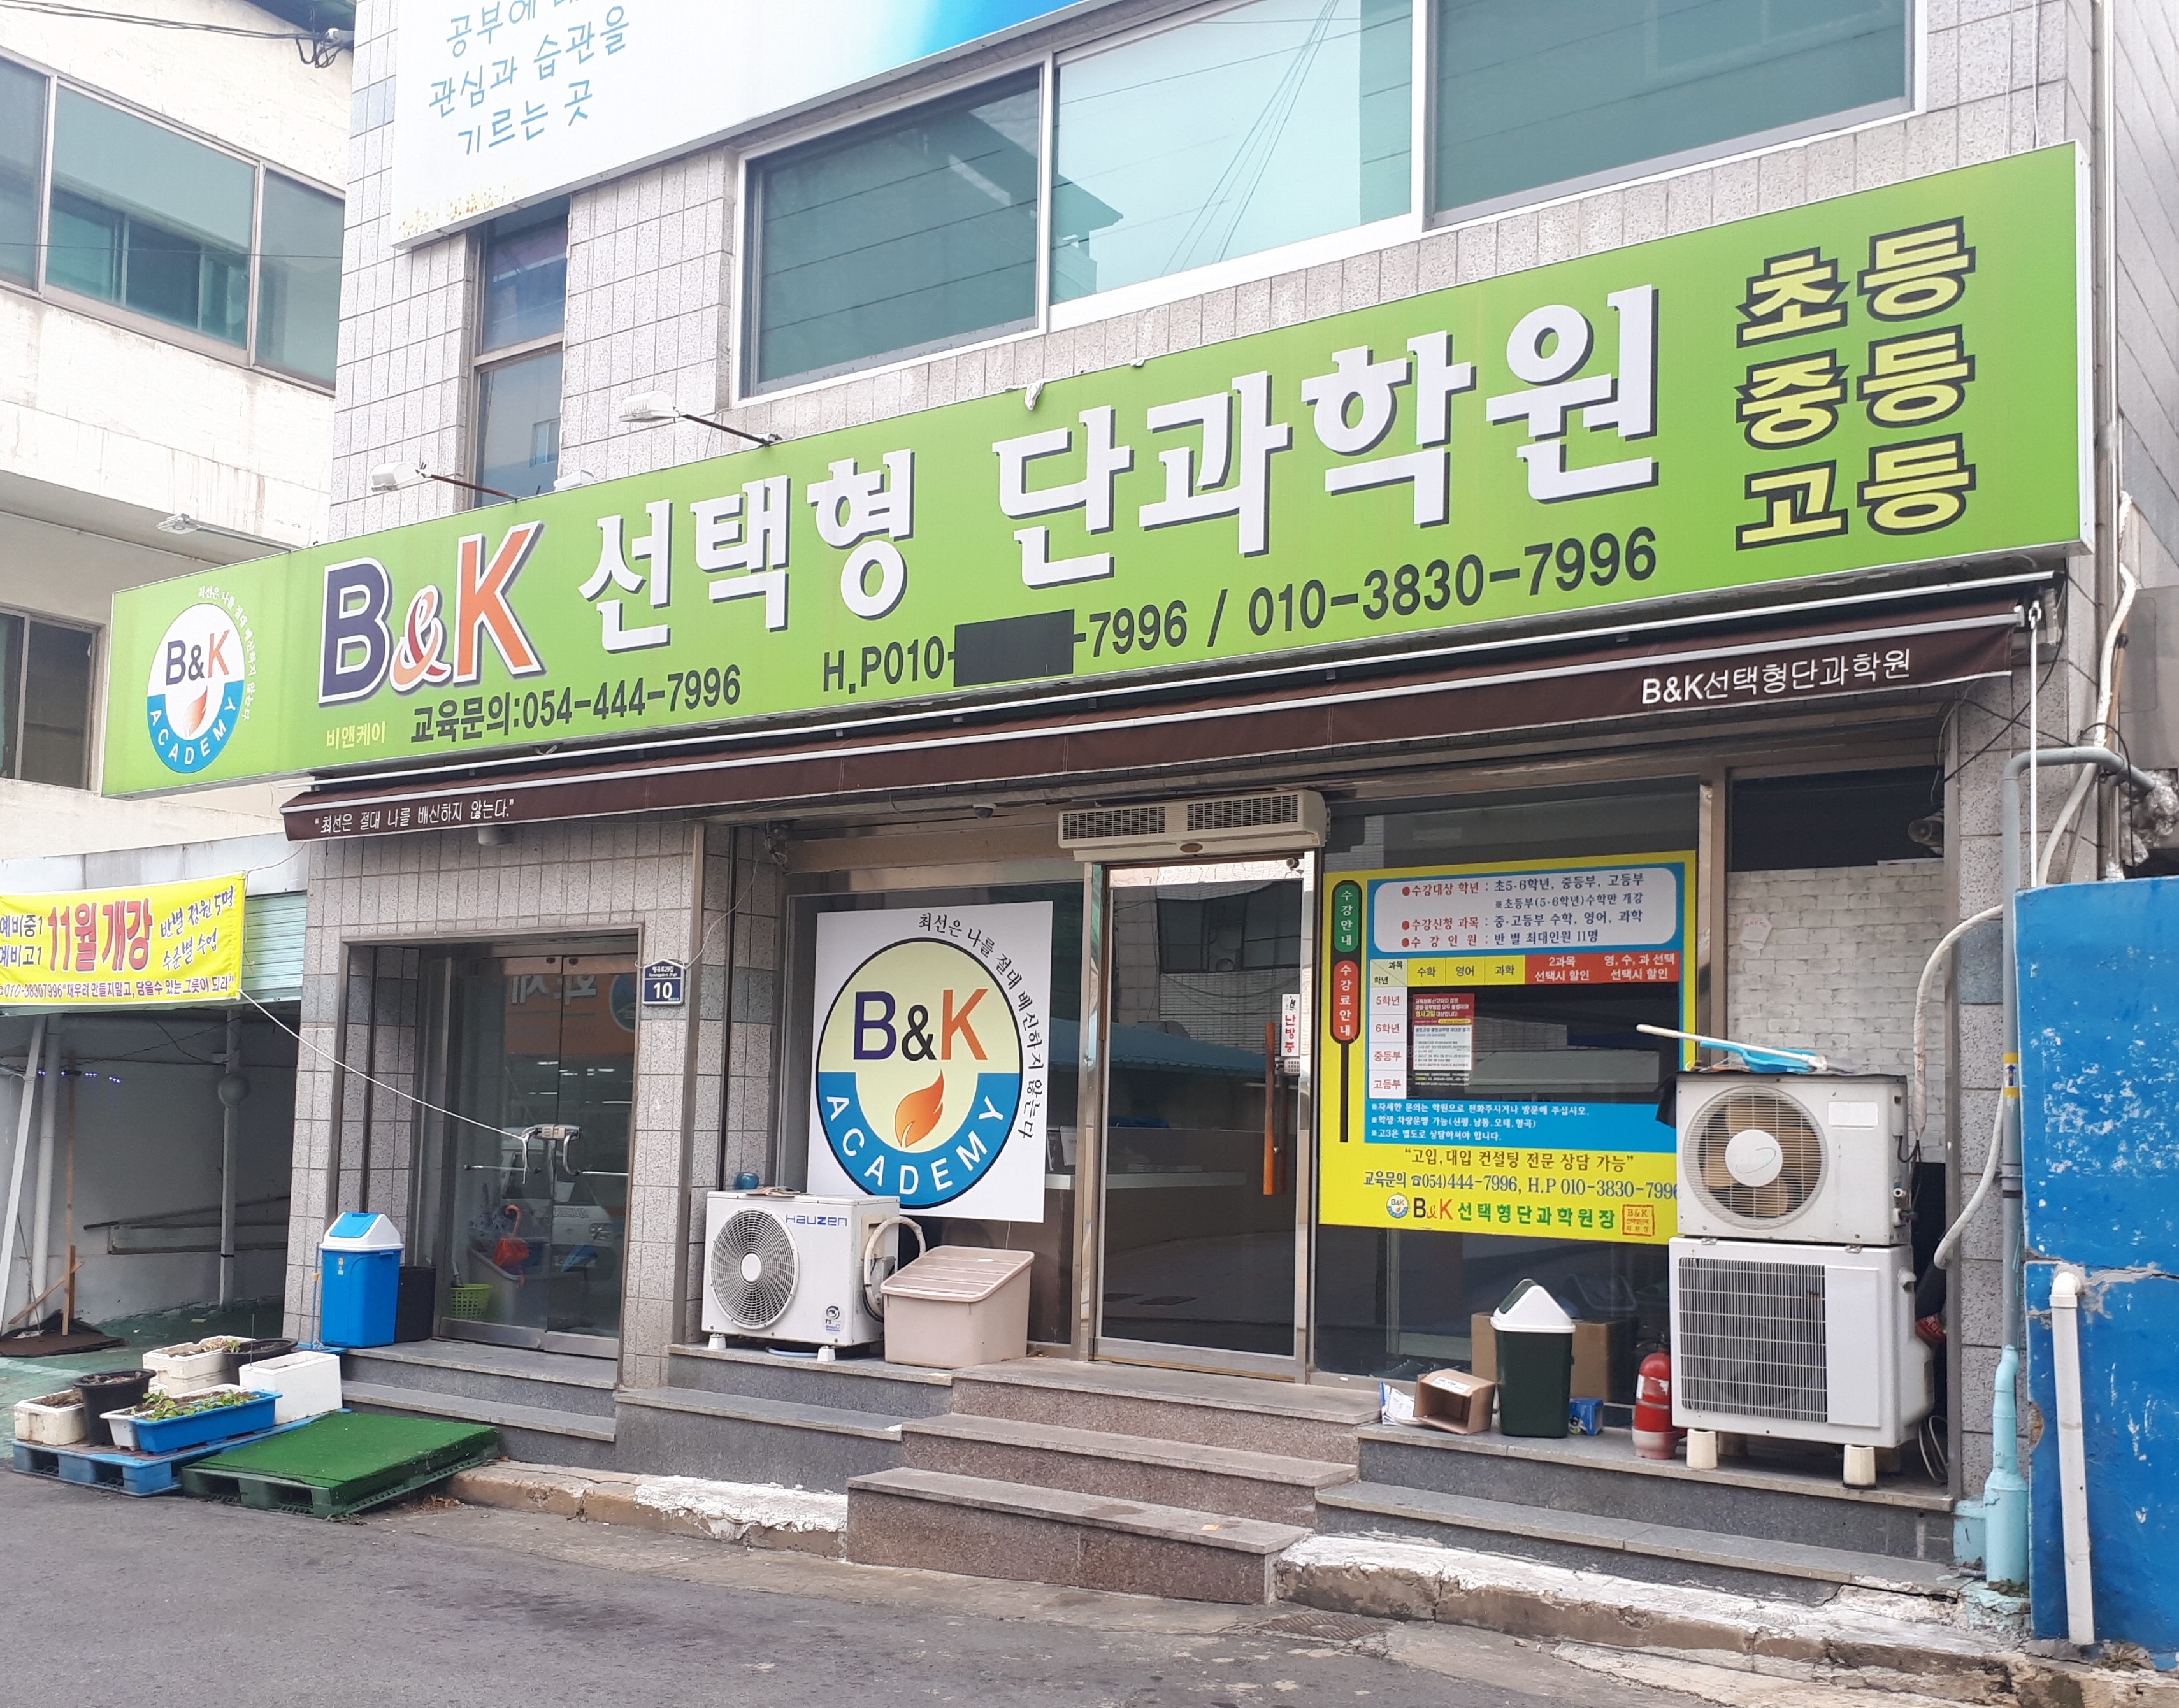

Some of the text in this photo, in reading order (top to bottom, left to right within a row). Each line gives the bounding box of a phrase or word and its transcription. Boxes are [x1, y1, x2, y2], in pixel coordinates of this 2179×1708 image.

[429, 6, 629, 119] 관심과 습관을
[457, 80, 593, 155] 기르는 곳
[1736, 215, 1976, 348] 초등
[1734, 324, 1976, 450] 중등
[318, 283, 1659, 707] B&K 선택형 단과학원
[1736, 432, 1976, 551] 고등
[1248, 527, 1657, 636] 010-3830-7996
[198, 585, 220, 599] 최선은
[221, 592, 235, 610] 나를
[165, 629, 230, 686] B&K
[1641, 648, 1911, 705] B&K선택형단과학원
[150, 697, 236, 764] ACADEMY
[326, 721, 386, 750] 비앤케이
[360, 810, 380, 830] 절대
[387, 807, 411, 827] 나를
[418, 801, 463, 824] 배신하지
[1411, 883, 1454, 897] 수강대상
[1458, 881, 1479, 895] 학년
[1607, 872, 1644, 887] 고등부
[1622, 891, 1644, 905] 개강
[161, 885, 233, 937] 반별 정원 5명
[1411, 917, 1453, 931] 수강신청
[1457, 916, 1479, 929] 과목
[1618, 909, 1643, 923] 과학
[0, 914, 43, 937] 예비중1
[48, 898, 153, 972] 11월 개강
[1526, 929, 1572, 945] 최대인원
[0, 945, 41, 967] 예비고1
[162, 927, 217, 970] 수준별 수업
[1653, 952, 1675, 965] 선택
[1388, 961, 1403, 970] 과목
[1417, 966, 1436, 978] 수학
[1455, 965, 1474, 977] 영어
[1495, 964, 1515, 976] 과학
[1549, 956, 1576, 967] 2과목
[1374, 976, 1388, 985] 학년
[1534, 969, 1590, 982] 선택시 할인
[1610, 967, 1668, 980] 선택시 할인
[165, 979, 182, 995] 있는
[183, 977, 209, 994] 그릇이
[653, 982, 673, 999] 10
[1376, 995, 1400, 1007] 5학년
[852, 988, 989, 1061] B&K
[918, 912, 1044, 1139] 최선은 나를 절대 배신하지 않는다
[1284, 1014, 1296, 1053] 난방중
[1375, 1023, 1400, 1035] 6학년
[1373, 1051, 1402, 1063] 중등부
[1373, 1078, 1402, 1090] 고등부
[1397, 1116, 1429, 1126] 차량운행
[1405, 1103, 1429, 1113] 문의는
[1432, 1103, 1465, 1113] 학원으로
[1468, 1104, 1519, 1115] 전화주시거나
[1521, 1105, 1548, 1116] 방문해
[826, 1096, 1005, 1195] ACADEMY
[1402, 1129, 1427, 1139] 별도로
[1430, 1130, 1471, 1141] 상담하셔야
[1478, 1151, 1520, 1169] 컨설팅
[1527, 1152, 1555, 1169] 전문
[1560, 1153, 1590, 1172] 상담
[1363, 1170, 1407, 1189] 교육문의
[1528, 1177, 1557, 1194] H.P
[1413, 1197, 1453, 1221] B&K
